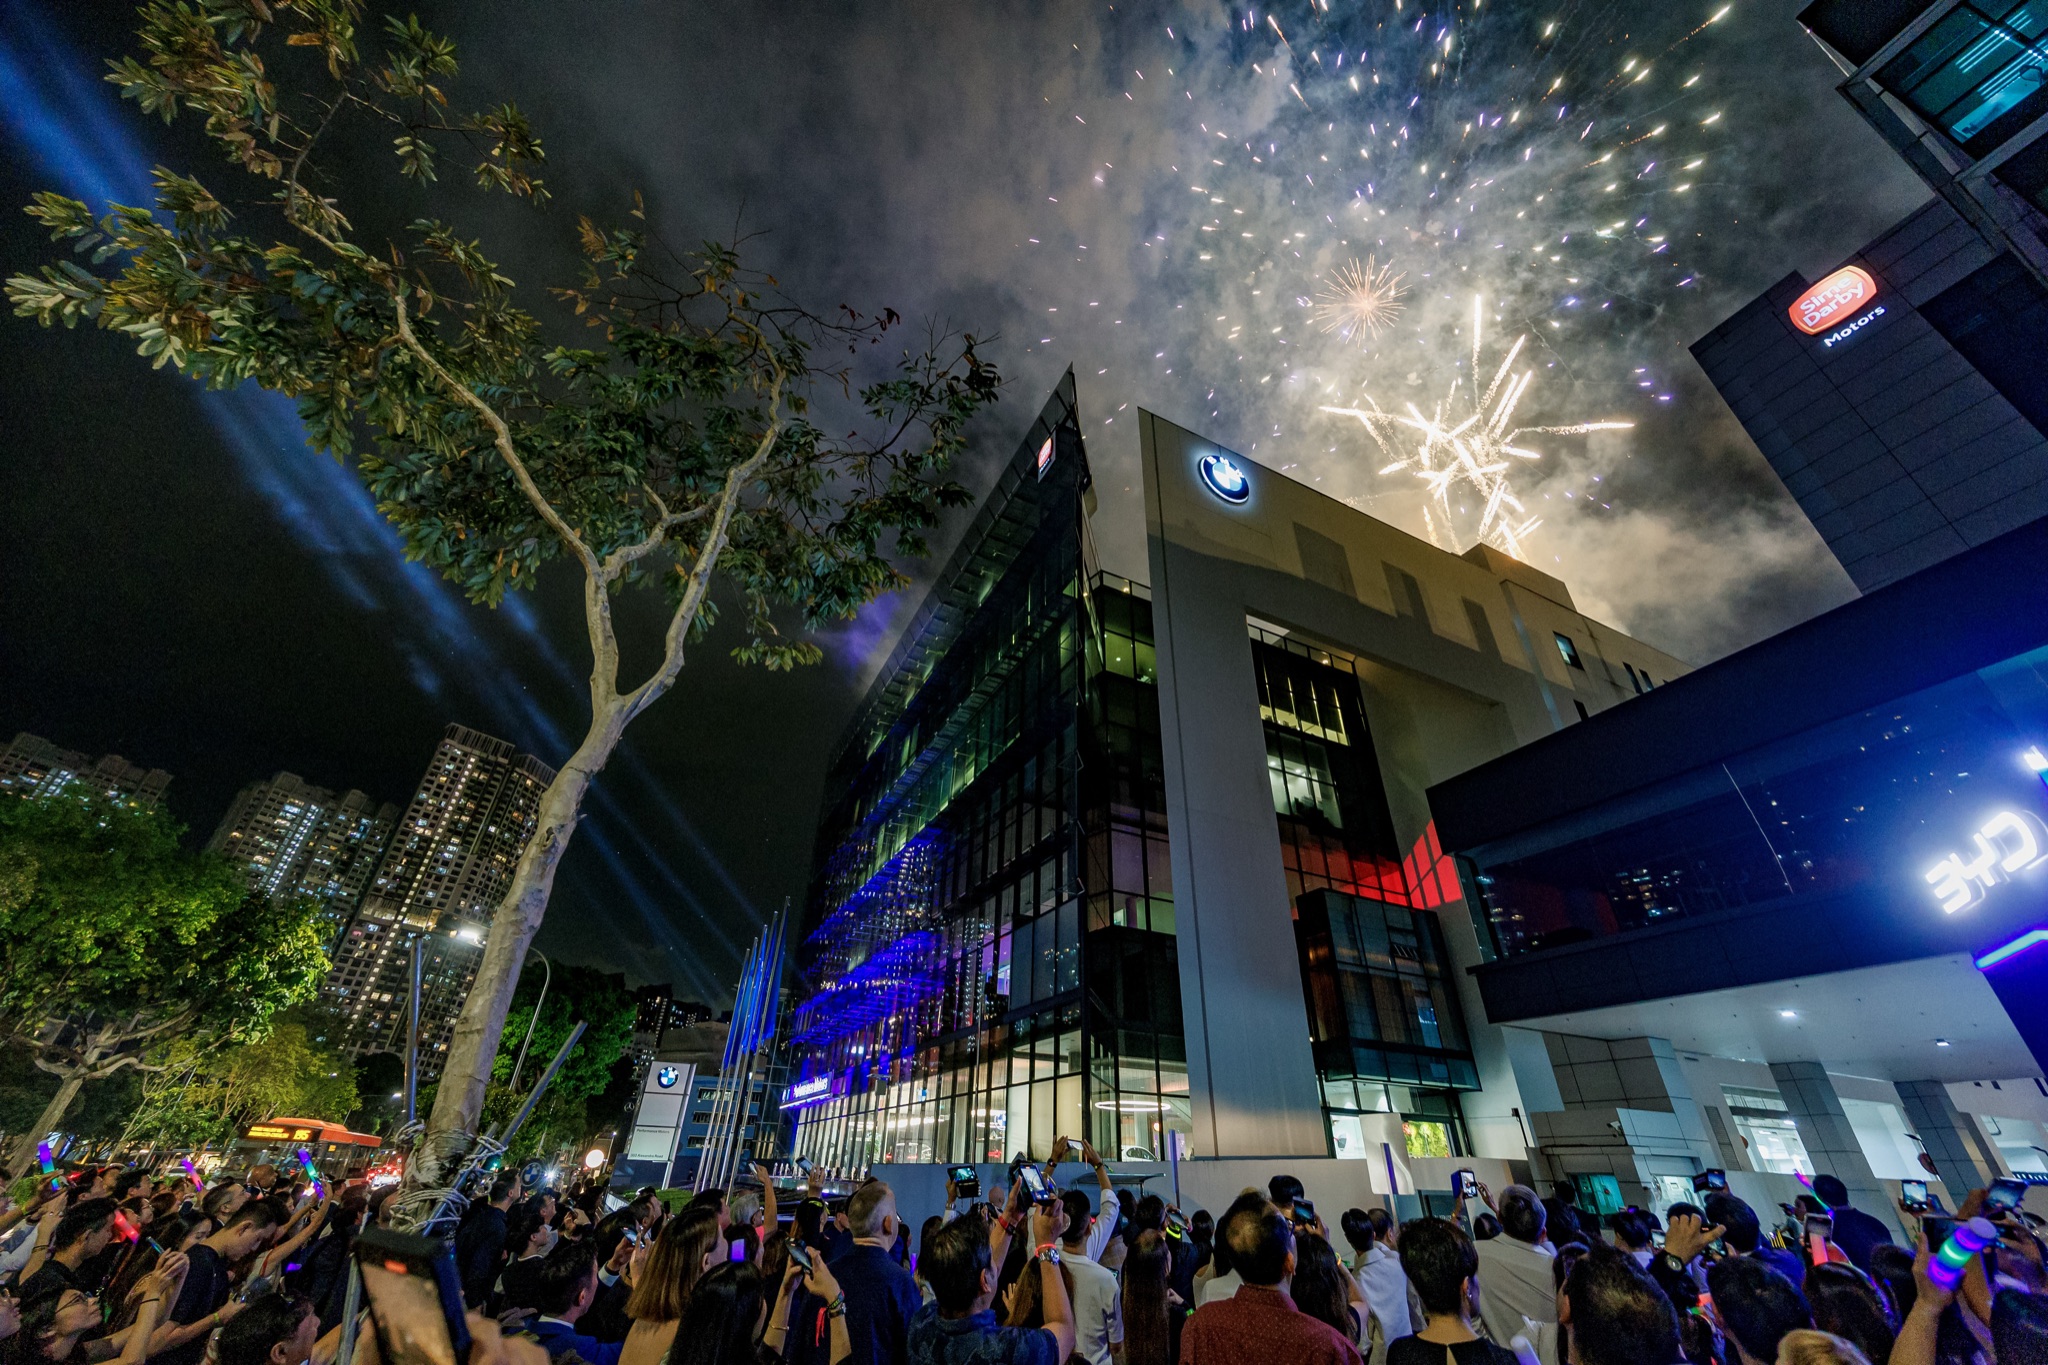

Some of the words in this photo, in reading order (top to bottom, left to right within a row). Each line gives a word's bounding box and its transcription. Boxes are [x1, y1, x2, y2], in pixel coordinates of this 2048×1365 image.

[1800, 277, 1852, 314] Sime
[1802, 282, 1864, 328] Darby
[1824, 306, 1885, 347] Motors
[1206, 455, 1245, 479] BMW
[1925, 811, 2038, 915] BYD
